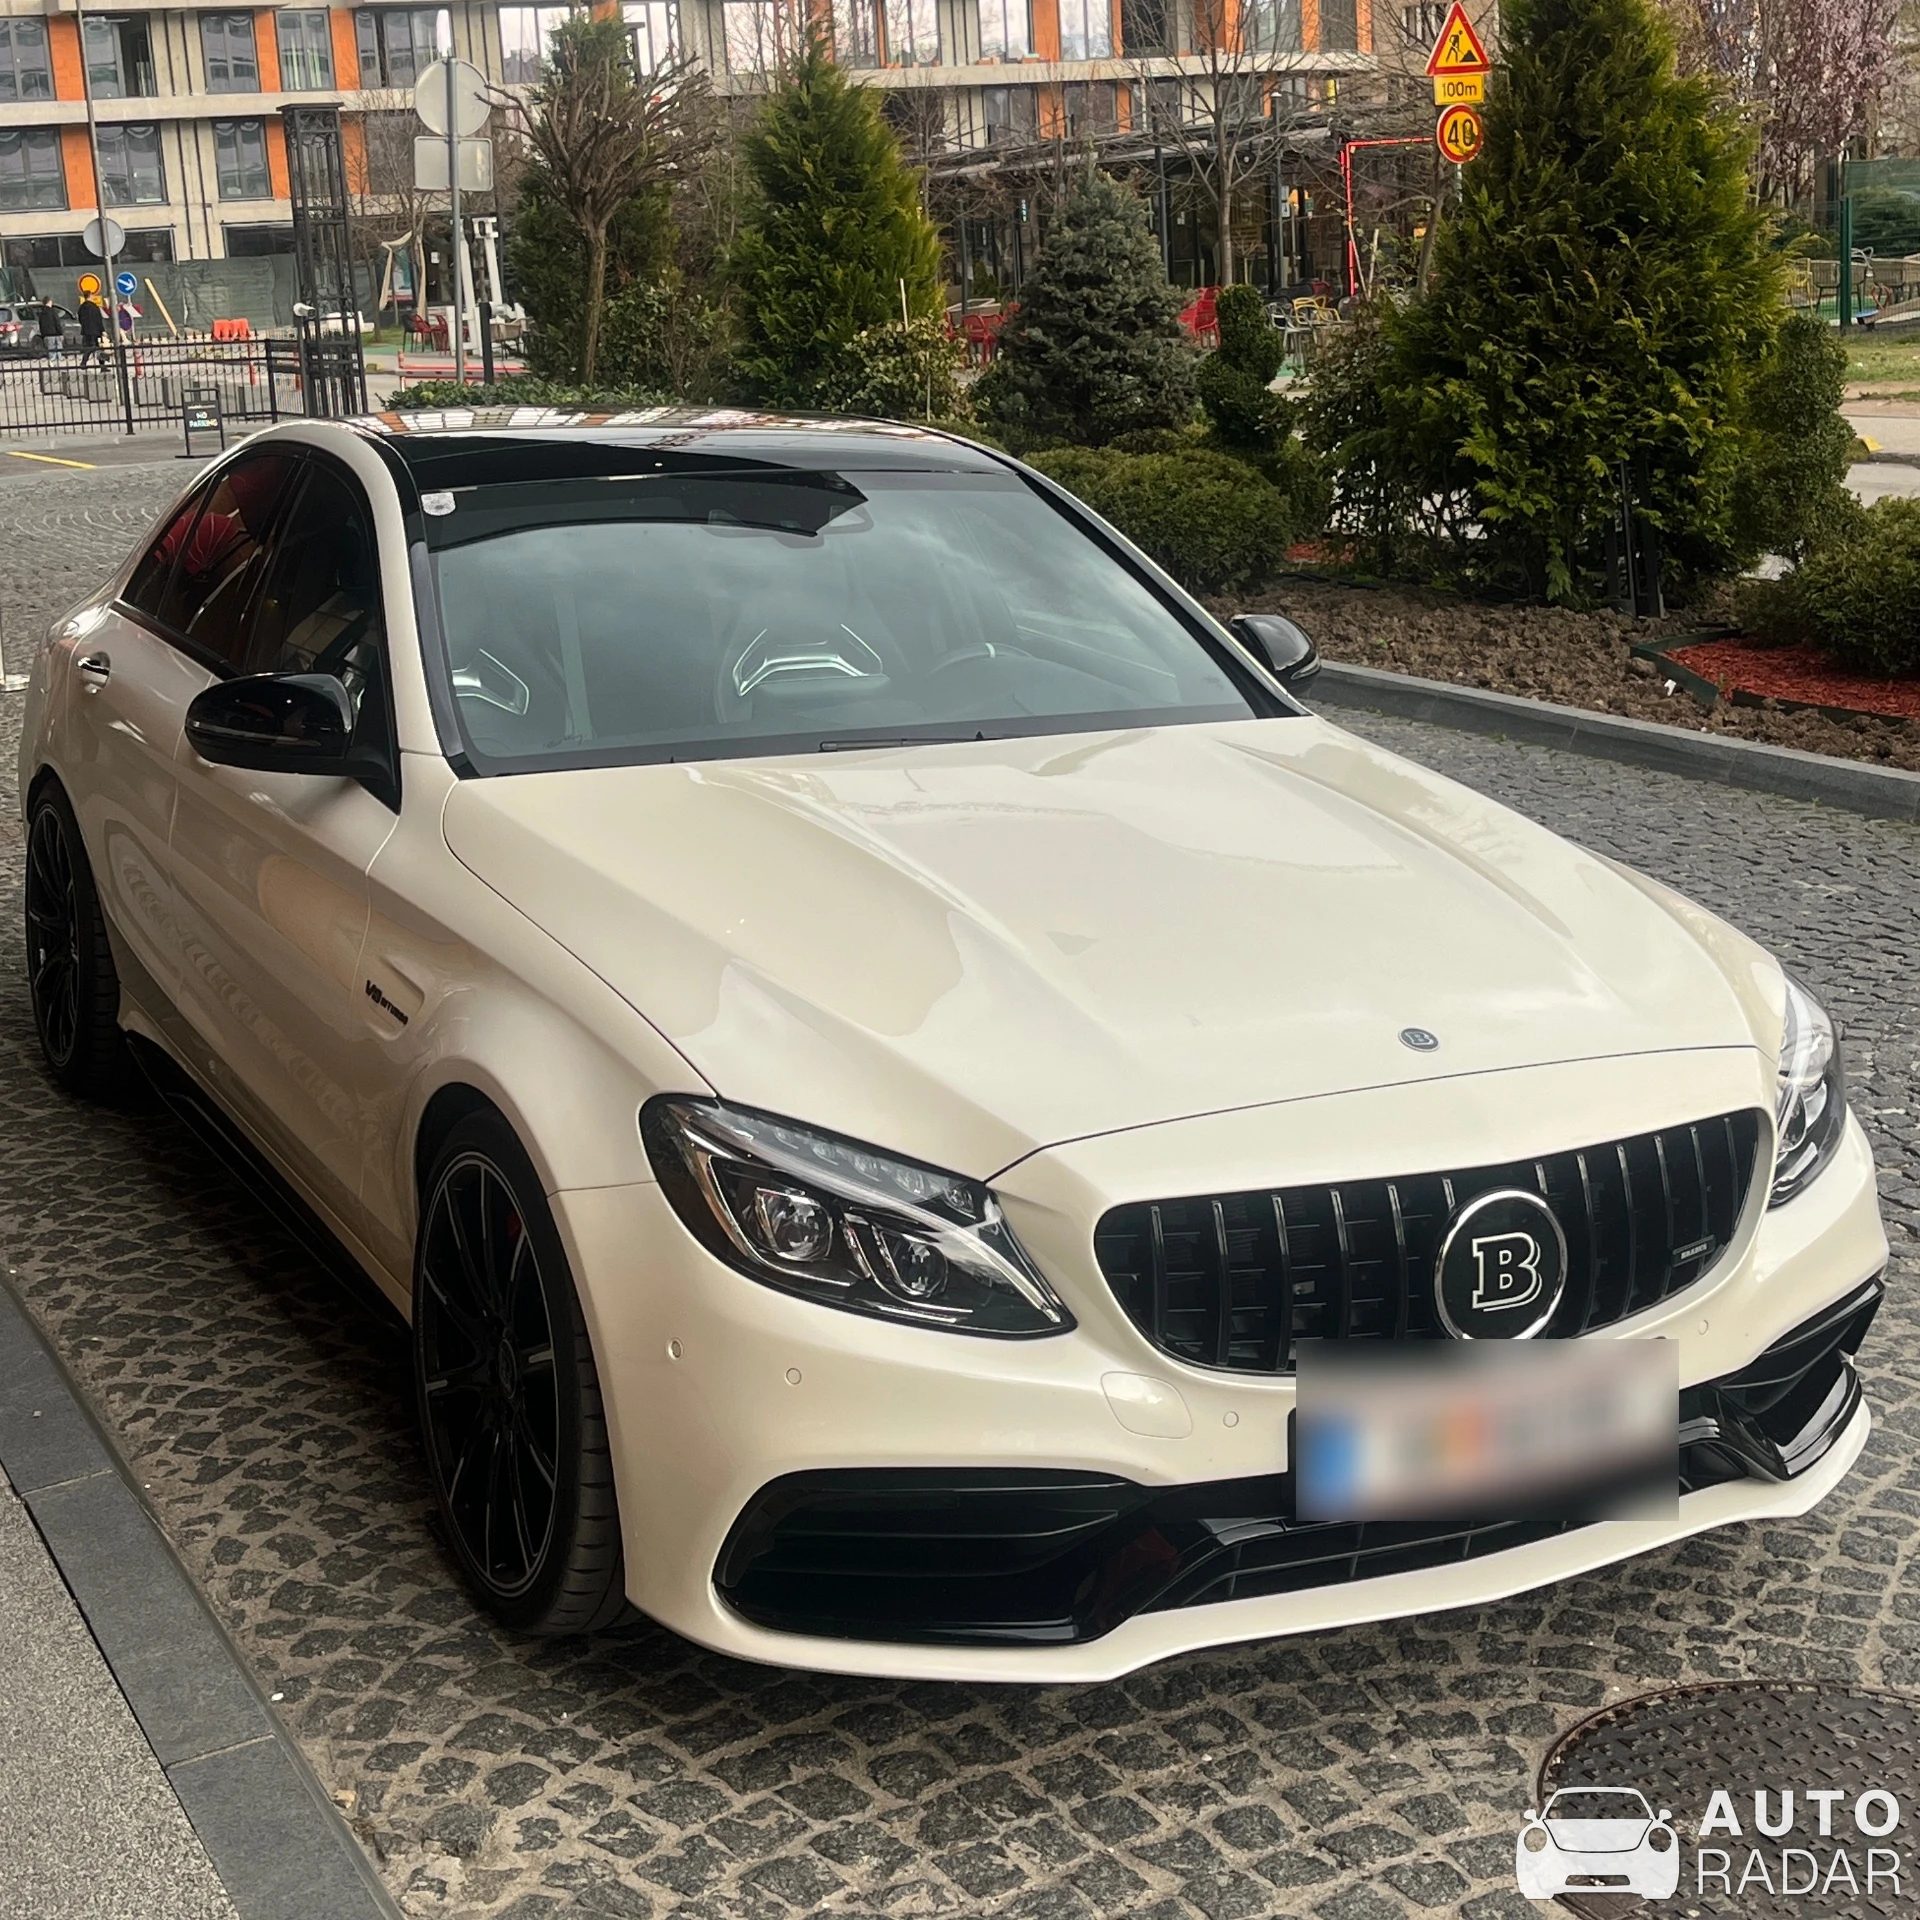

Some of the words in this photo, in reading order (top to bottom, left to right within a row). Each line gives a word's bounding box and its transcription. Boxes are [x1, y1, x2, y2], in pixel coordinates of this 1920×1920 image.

[1442, 82, 1477, 97] 100m
[1447, 119, 1474, 147] 40
[1471, 1231, 1543, 1312] B
